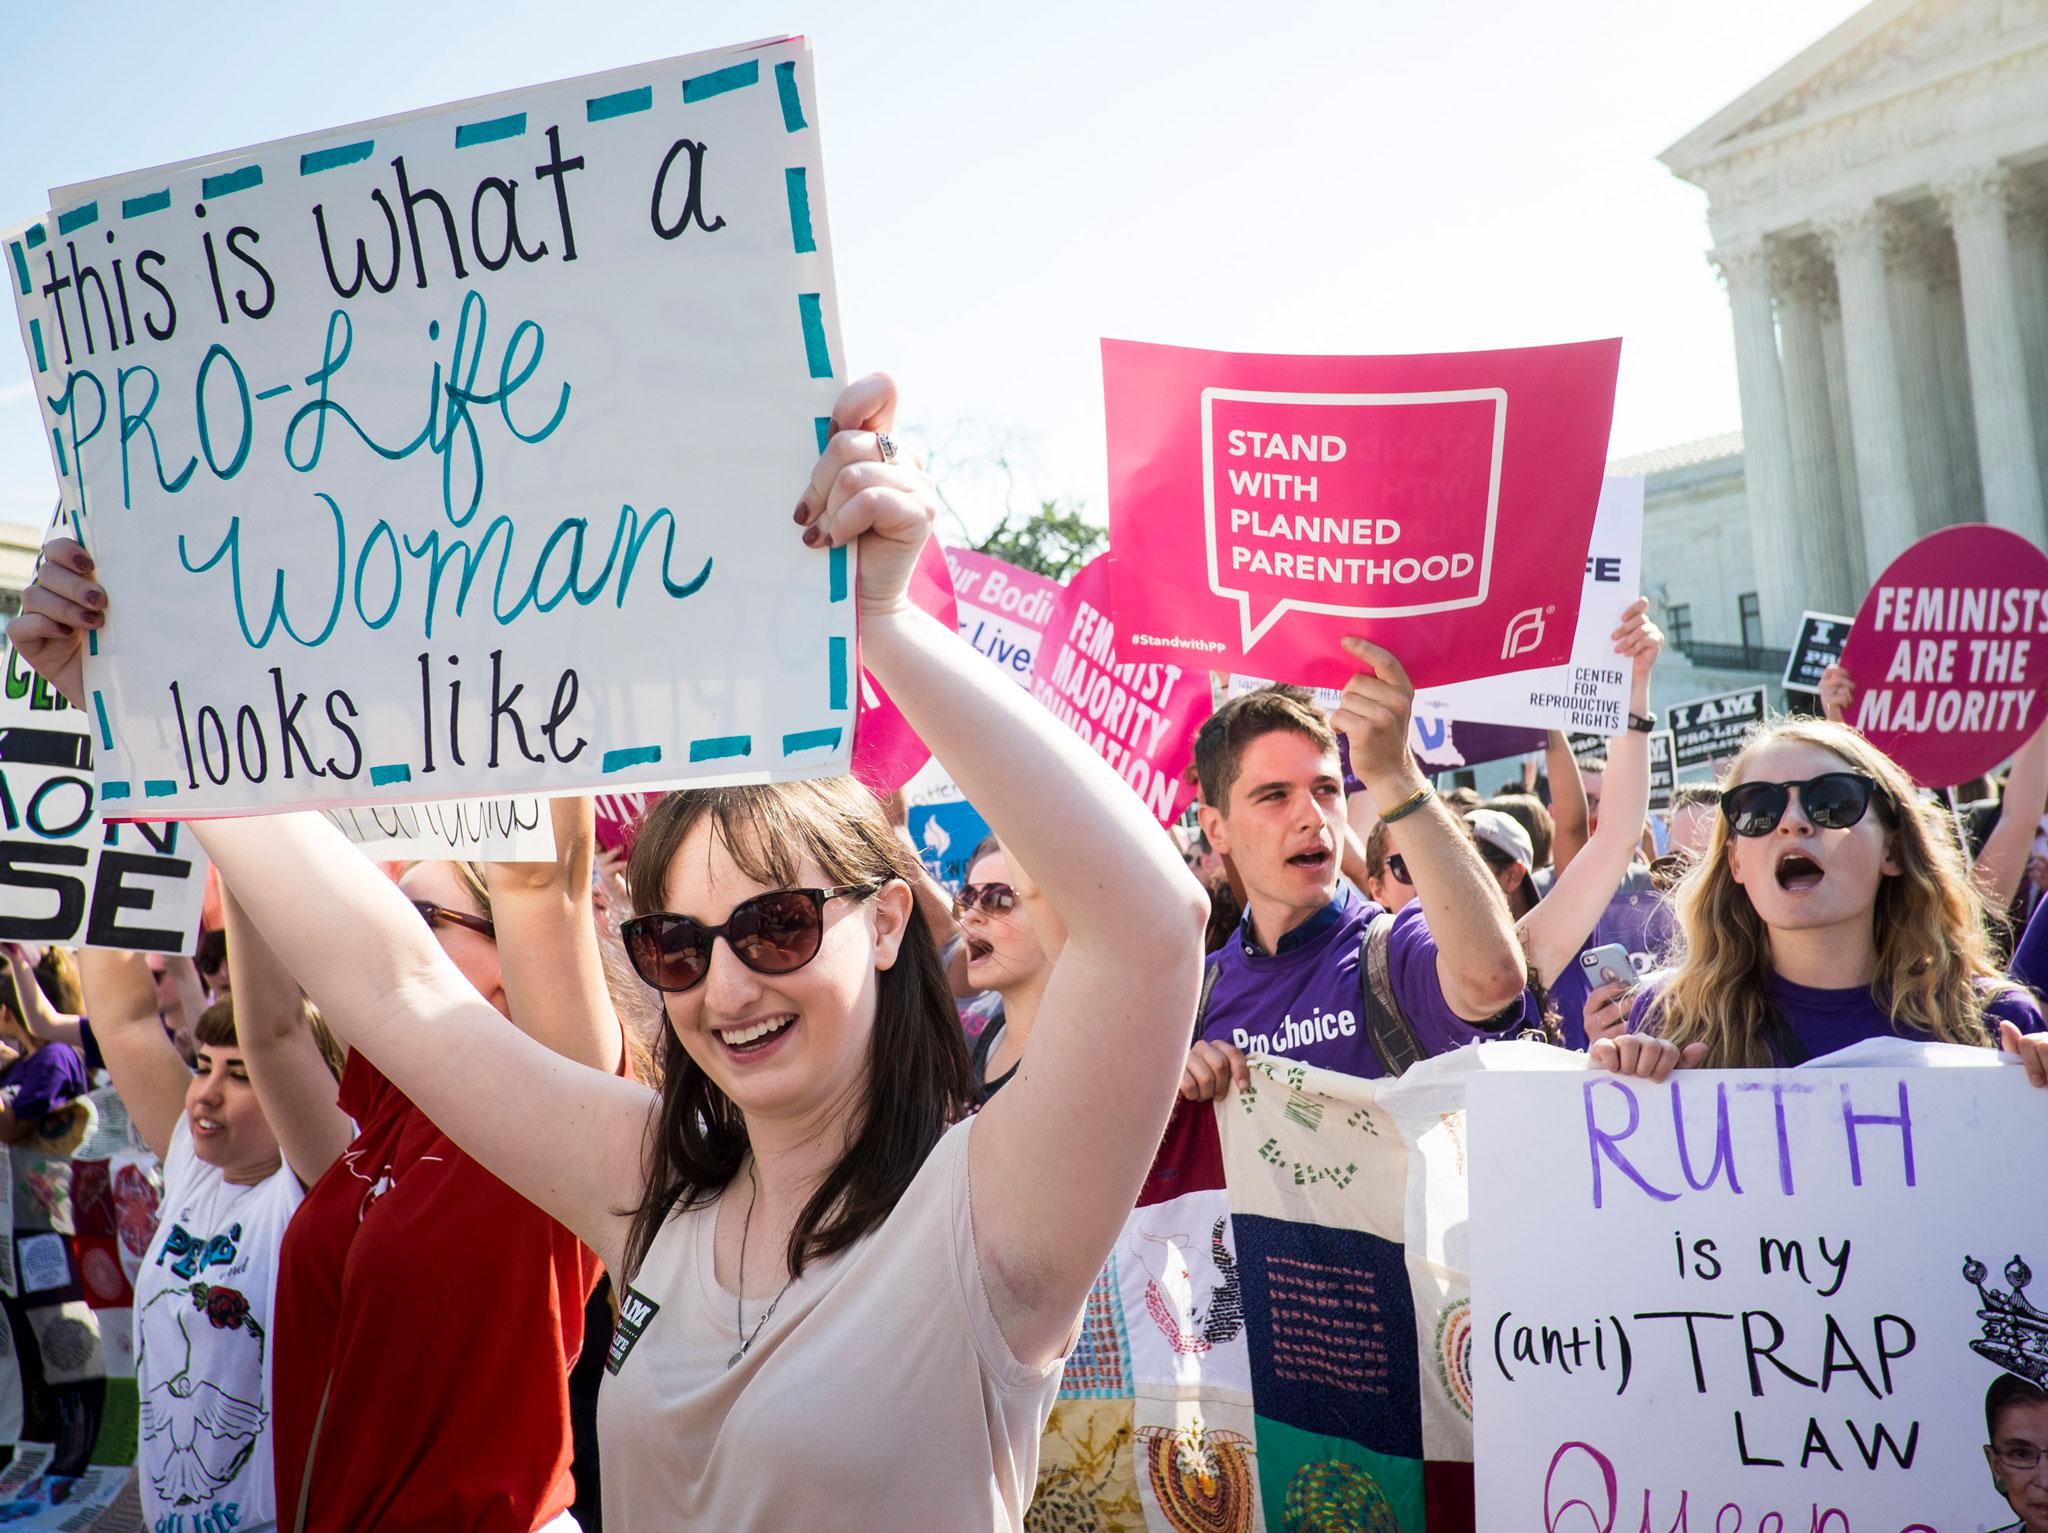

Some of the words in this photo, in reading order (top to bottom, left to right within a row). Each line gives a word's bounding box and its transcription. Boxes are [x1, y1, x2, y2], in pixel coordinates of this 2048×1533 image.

[43, 231, 177, 365] this
[193, 203, 276, 325] is
[312, 125, 585, 299] what
[649, 137, 726, 240] a
[1227, 428, 1348, 463] STAND
[1227, 468, 1319, 503] WITH
[1230, 508, 1401, 546] PLANNED
[178, 493, 713, 649] Woman
[1231, 546, 1475, 586] PARENTHOOD
[1131, 633, 1227, 654] #StandwithPP
[1885, 639, 1959, 684] ARE
[1968, 639, 2031, 684] THE
[1573, 681, 1598, 697] FOR
[1575, 667, 1624, 686] CENTER
[168, 667, 364, 790] looks
[418, 648, 590, 774] like
[1050, 642, 1172, 760] MAJORITY
[1529, 692, 1621, 715] REPRODUCTIVE
[1571, 711, 1620, 730] RIGHTS
[1674, 706, 1691, 729] I
[1695, 692, 1757, 725] AM
[1857, 688, 2037, 734] MAJORITY
[1676, 721, 1747, 748] PRO-LIF
[1232, 1027, 1270, 1055] Pro
[1271, 1006, 1357, 1052] Choice
[1582, 1076, 1917, 1210] RUTH
[1674, 1230, 1722, 1281] is
[1759, 1235, 1852, 1298] my
[1734, 1410, 1920, 1471] LAW
